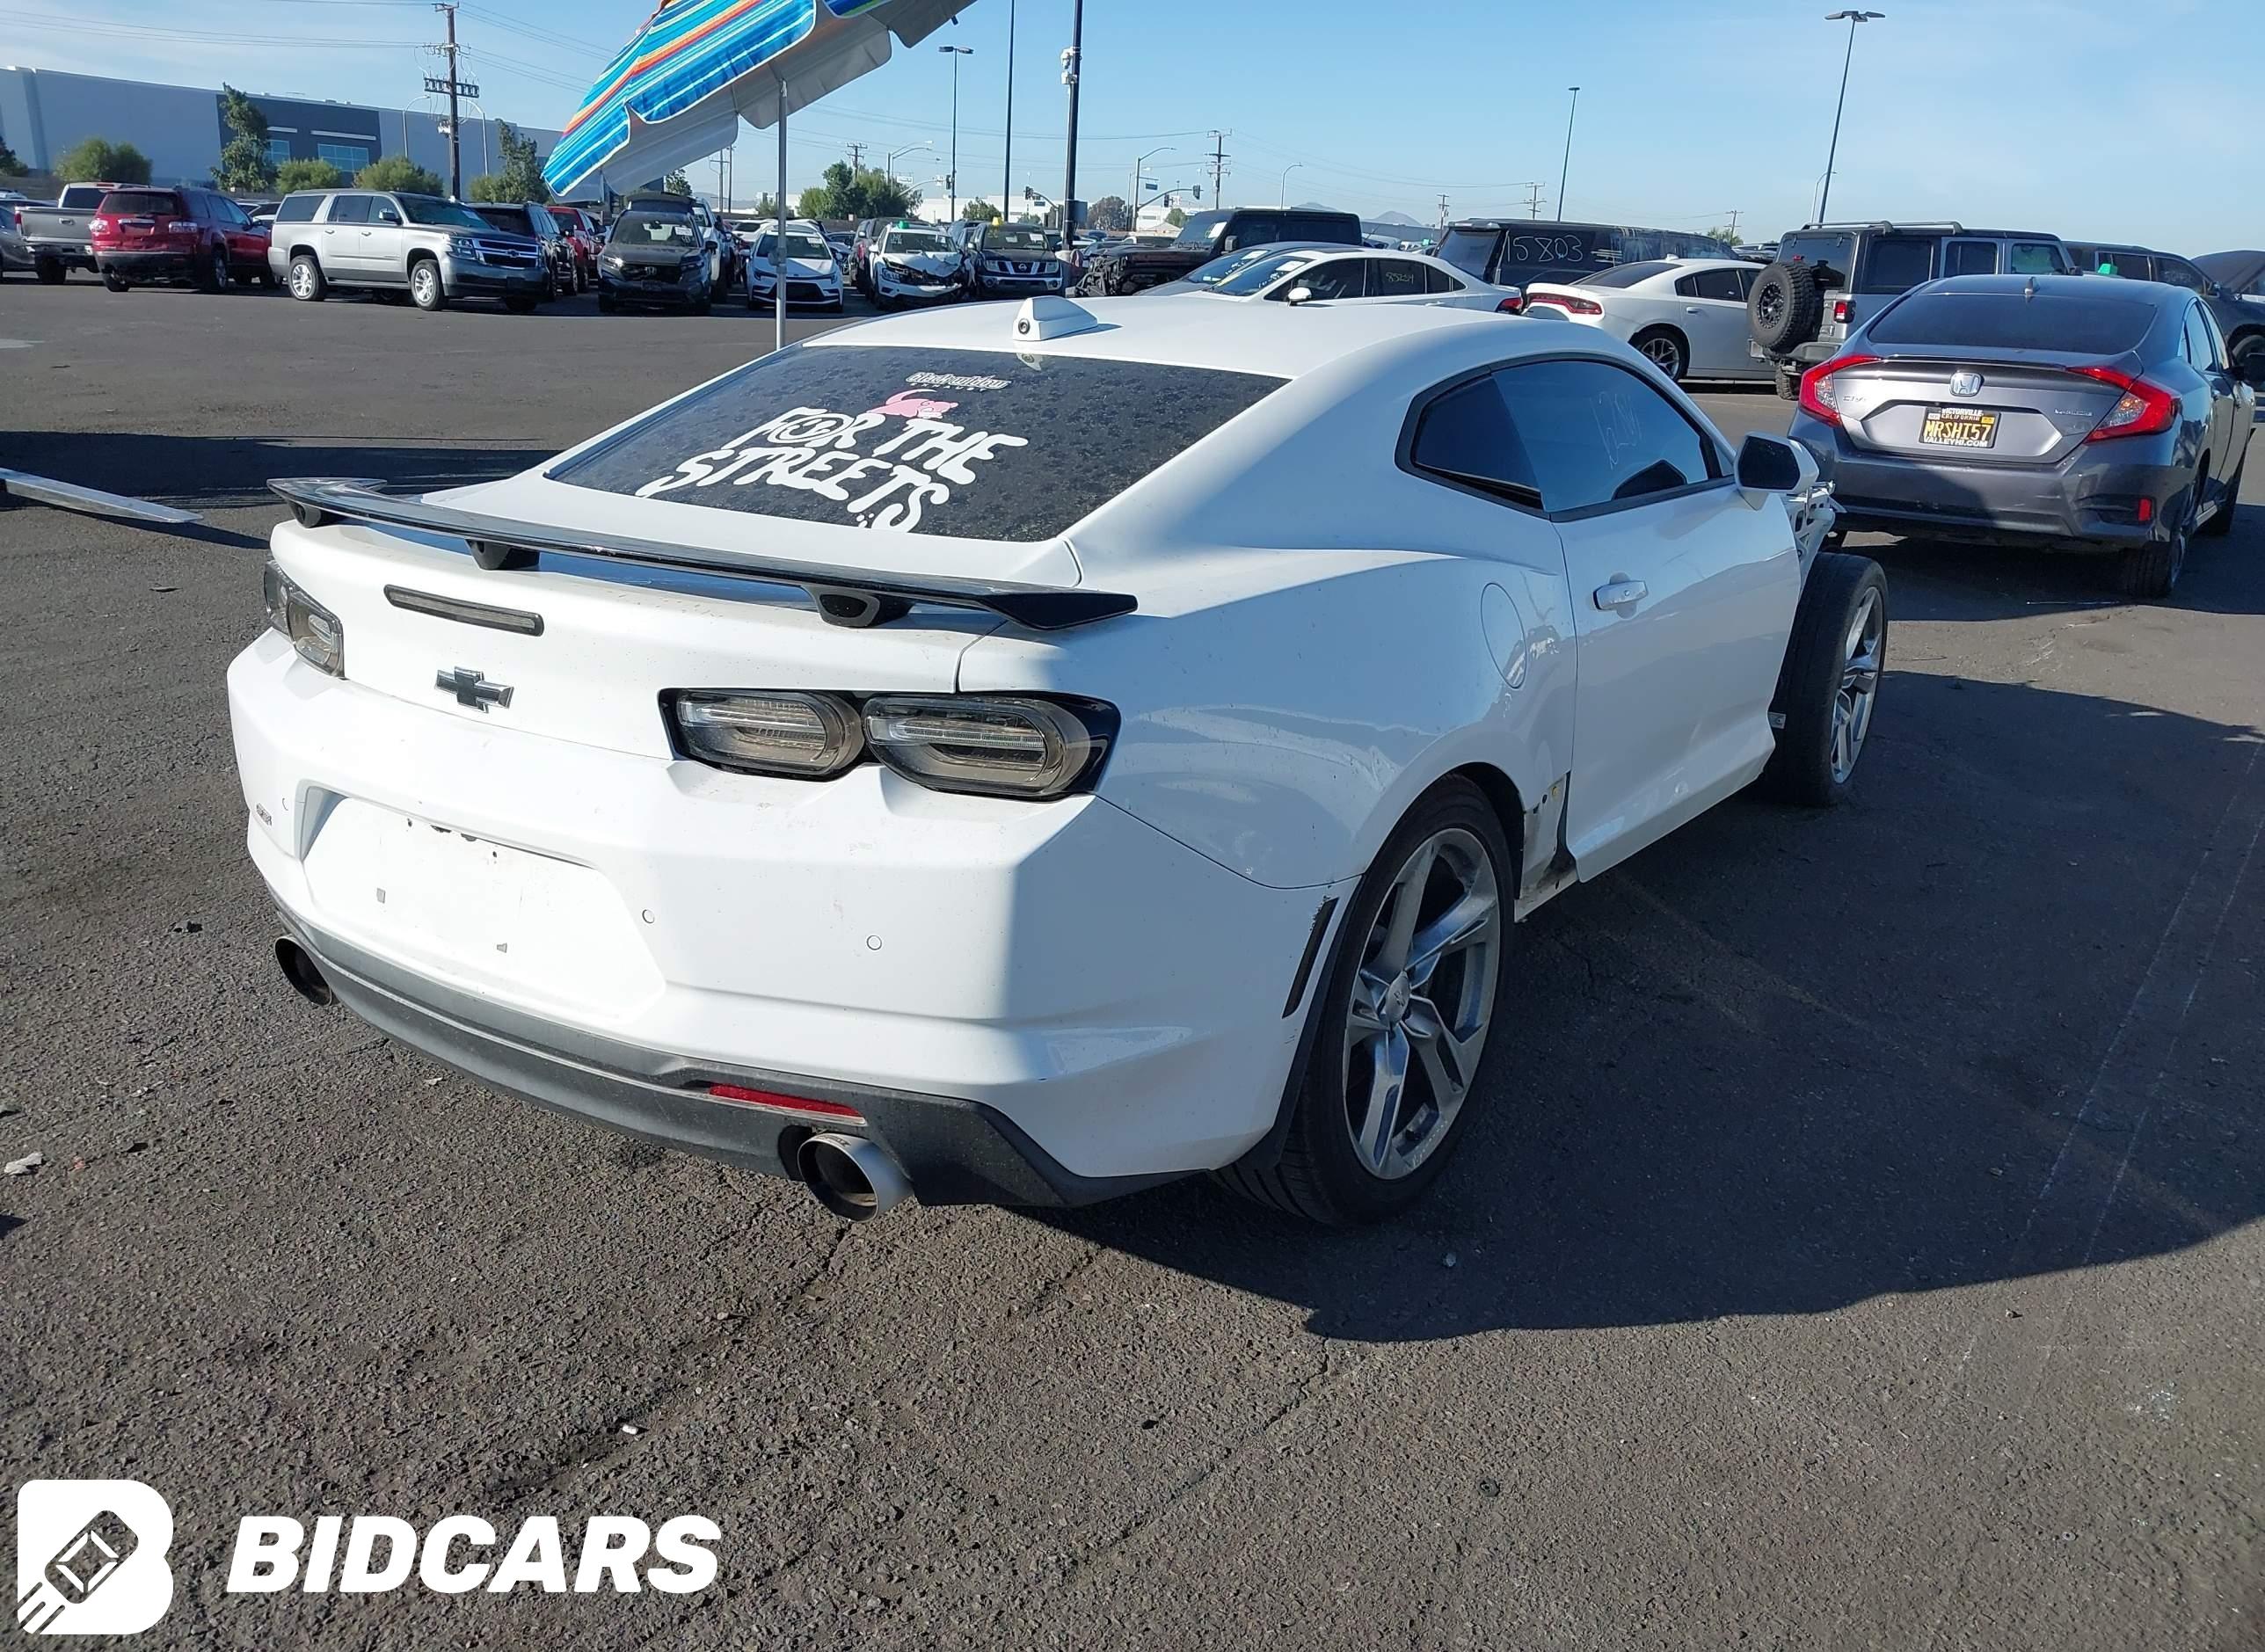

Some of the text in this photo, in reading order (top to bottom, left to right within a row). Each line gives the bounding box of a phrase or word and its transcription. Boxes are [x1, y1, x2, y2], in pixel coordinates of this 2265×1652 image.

[1506, 234, 1584, 262] 15803
[872, 418, 1029, 485] THE
[635, 446, 950, 534] STREETS
